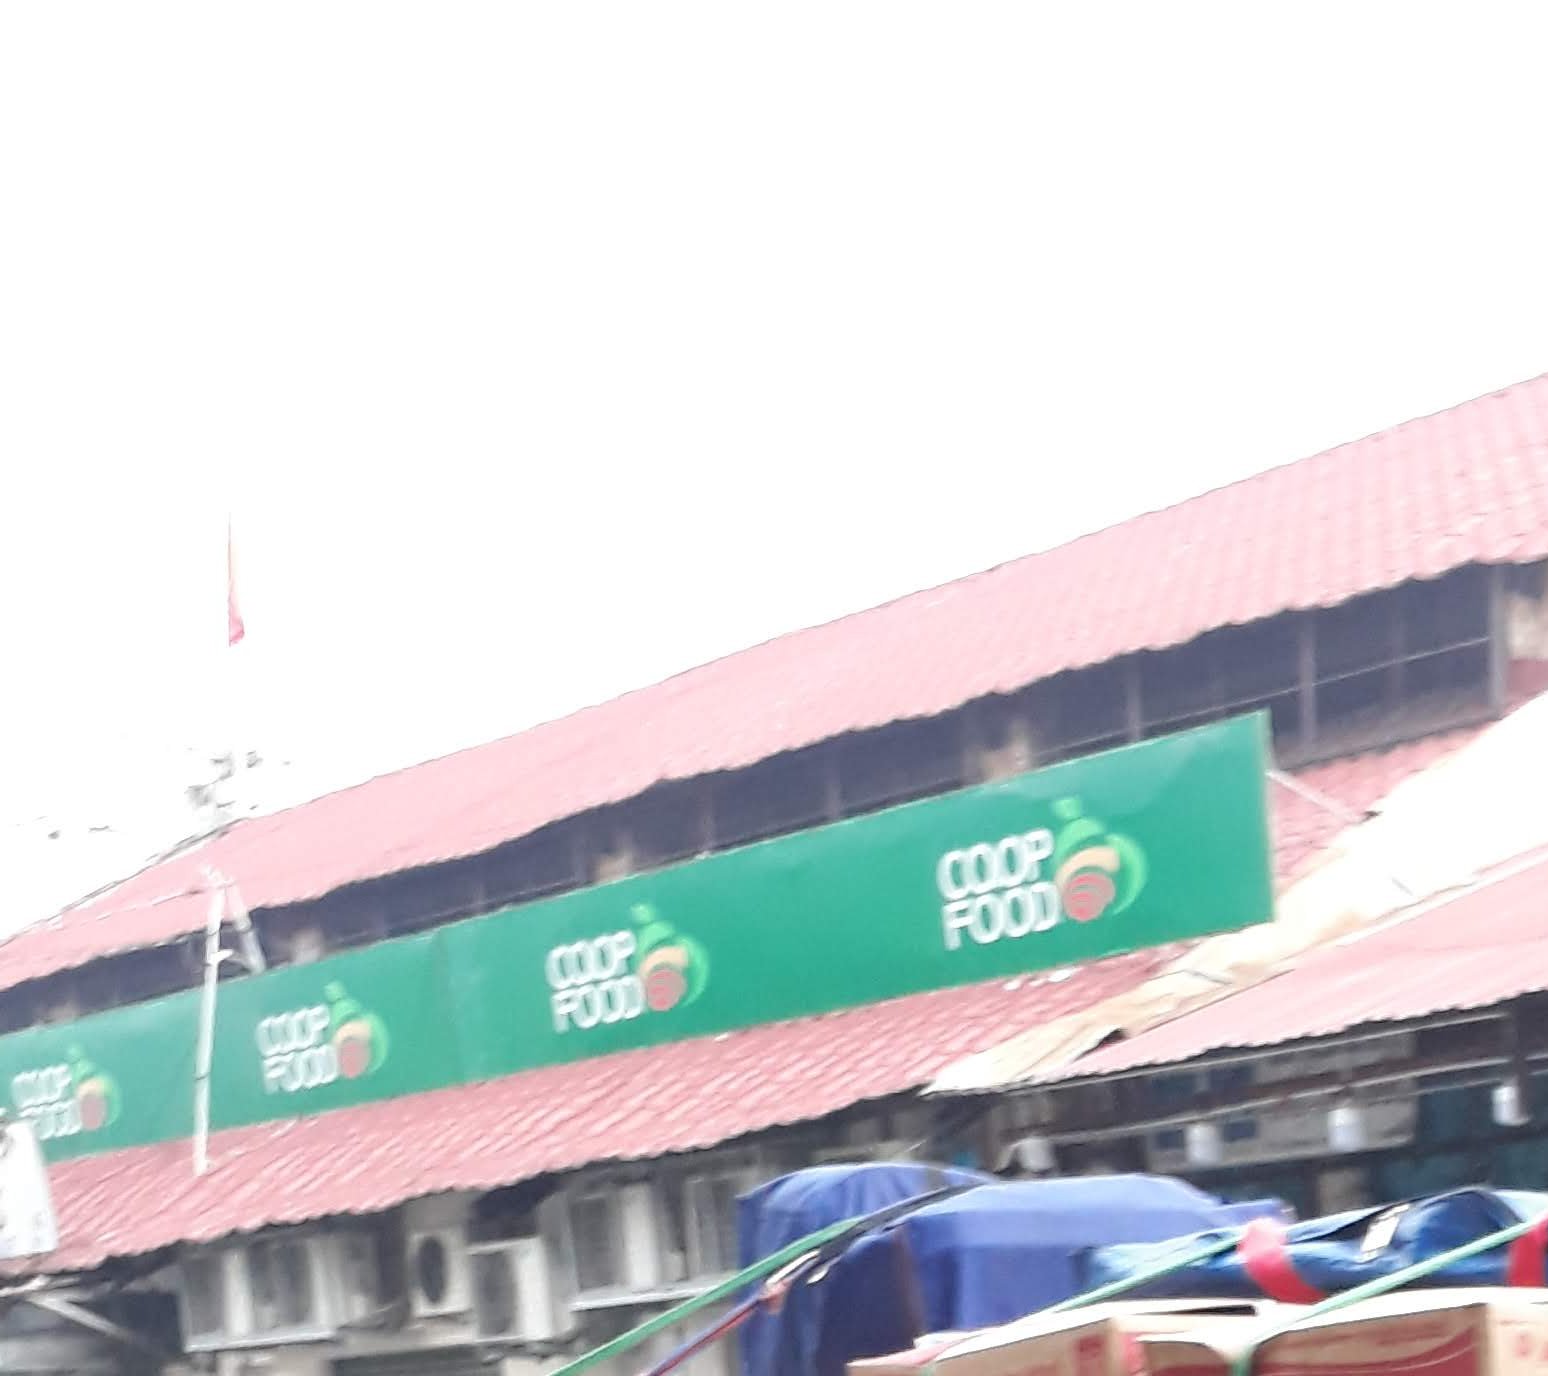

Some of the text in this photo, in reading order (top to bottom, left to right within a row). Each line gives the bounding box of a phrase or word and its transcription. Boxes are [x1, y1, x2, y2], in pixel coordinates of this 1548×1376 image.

[937, 828, 1055, 900] COOP
[941, 880, 1061, 950] FOOD
[545, 928, 637, 989] COOP
[255, 1003, 331, 1057] COOP
[551, 975, 647, 1034] FOOD
[262, 1043, 340, 1095] FOOD
